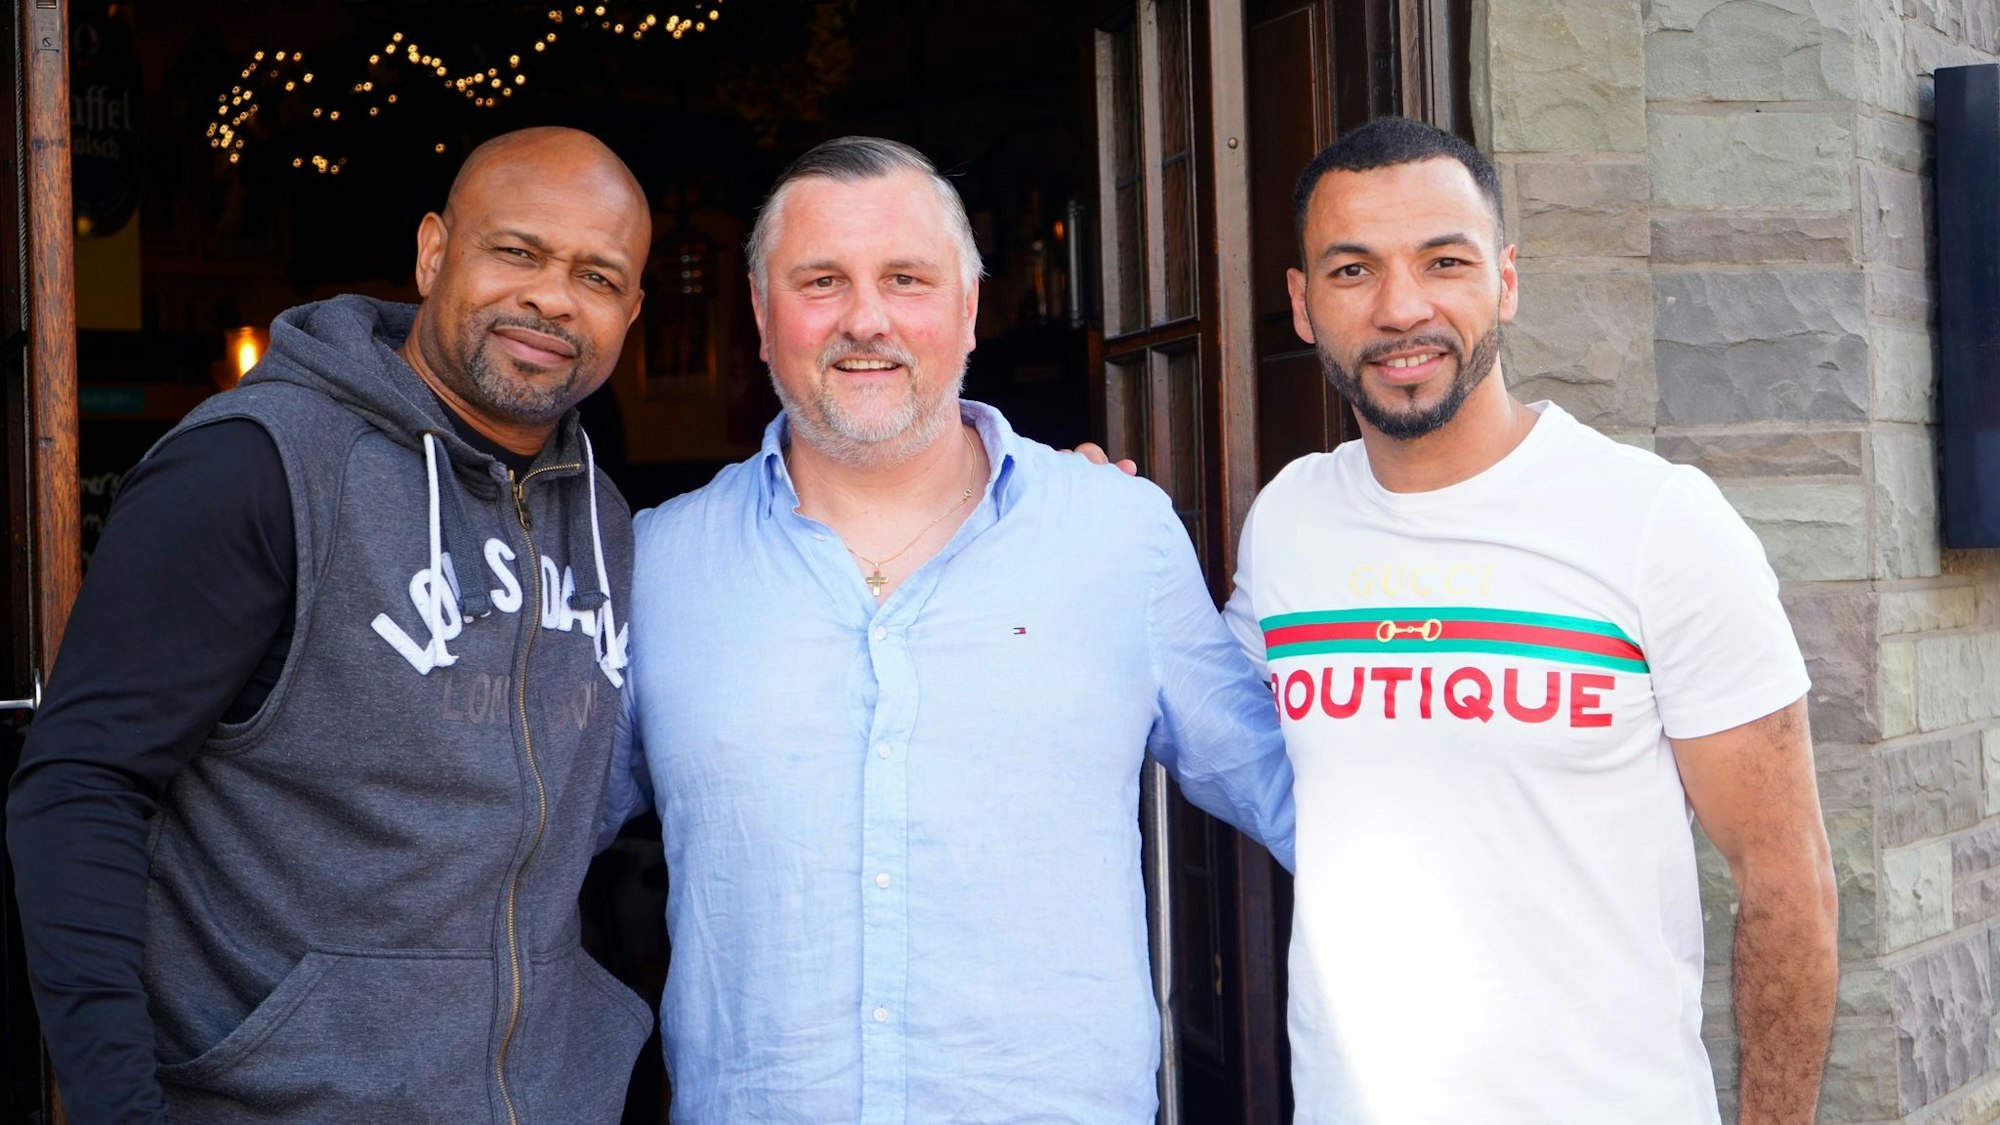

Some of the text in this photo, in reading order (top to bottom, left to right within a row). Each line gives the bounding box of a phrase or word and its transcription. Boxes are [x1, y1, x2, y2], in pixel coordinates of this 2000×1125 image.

[70, 84, 133, 131] affel
[1349, 563, 1493, 597] GUCCI
[371, 538, 629, 688] LOSDA
